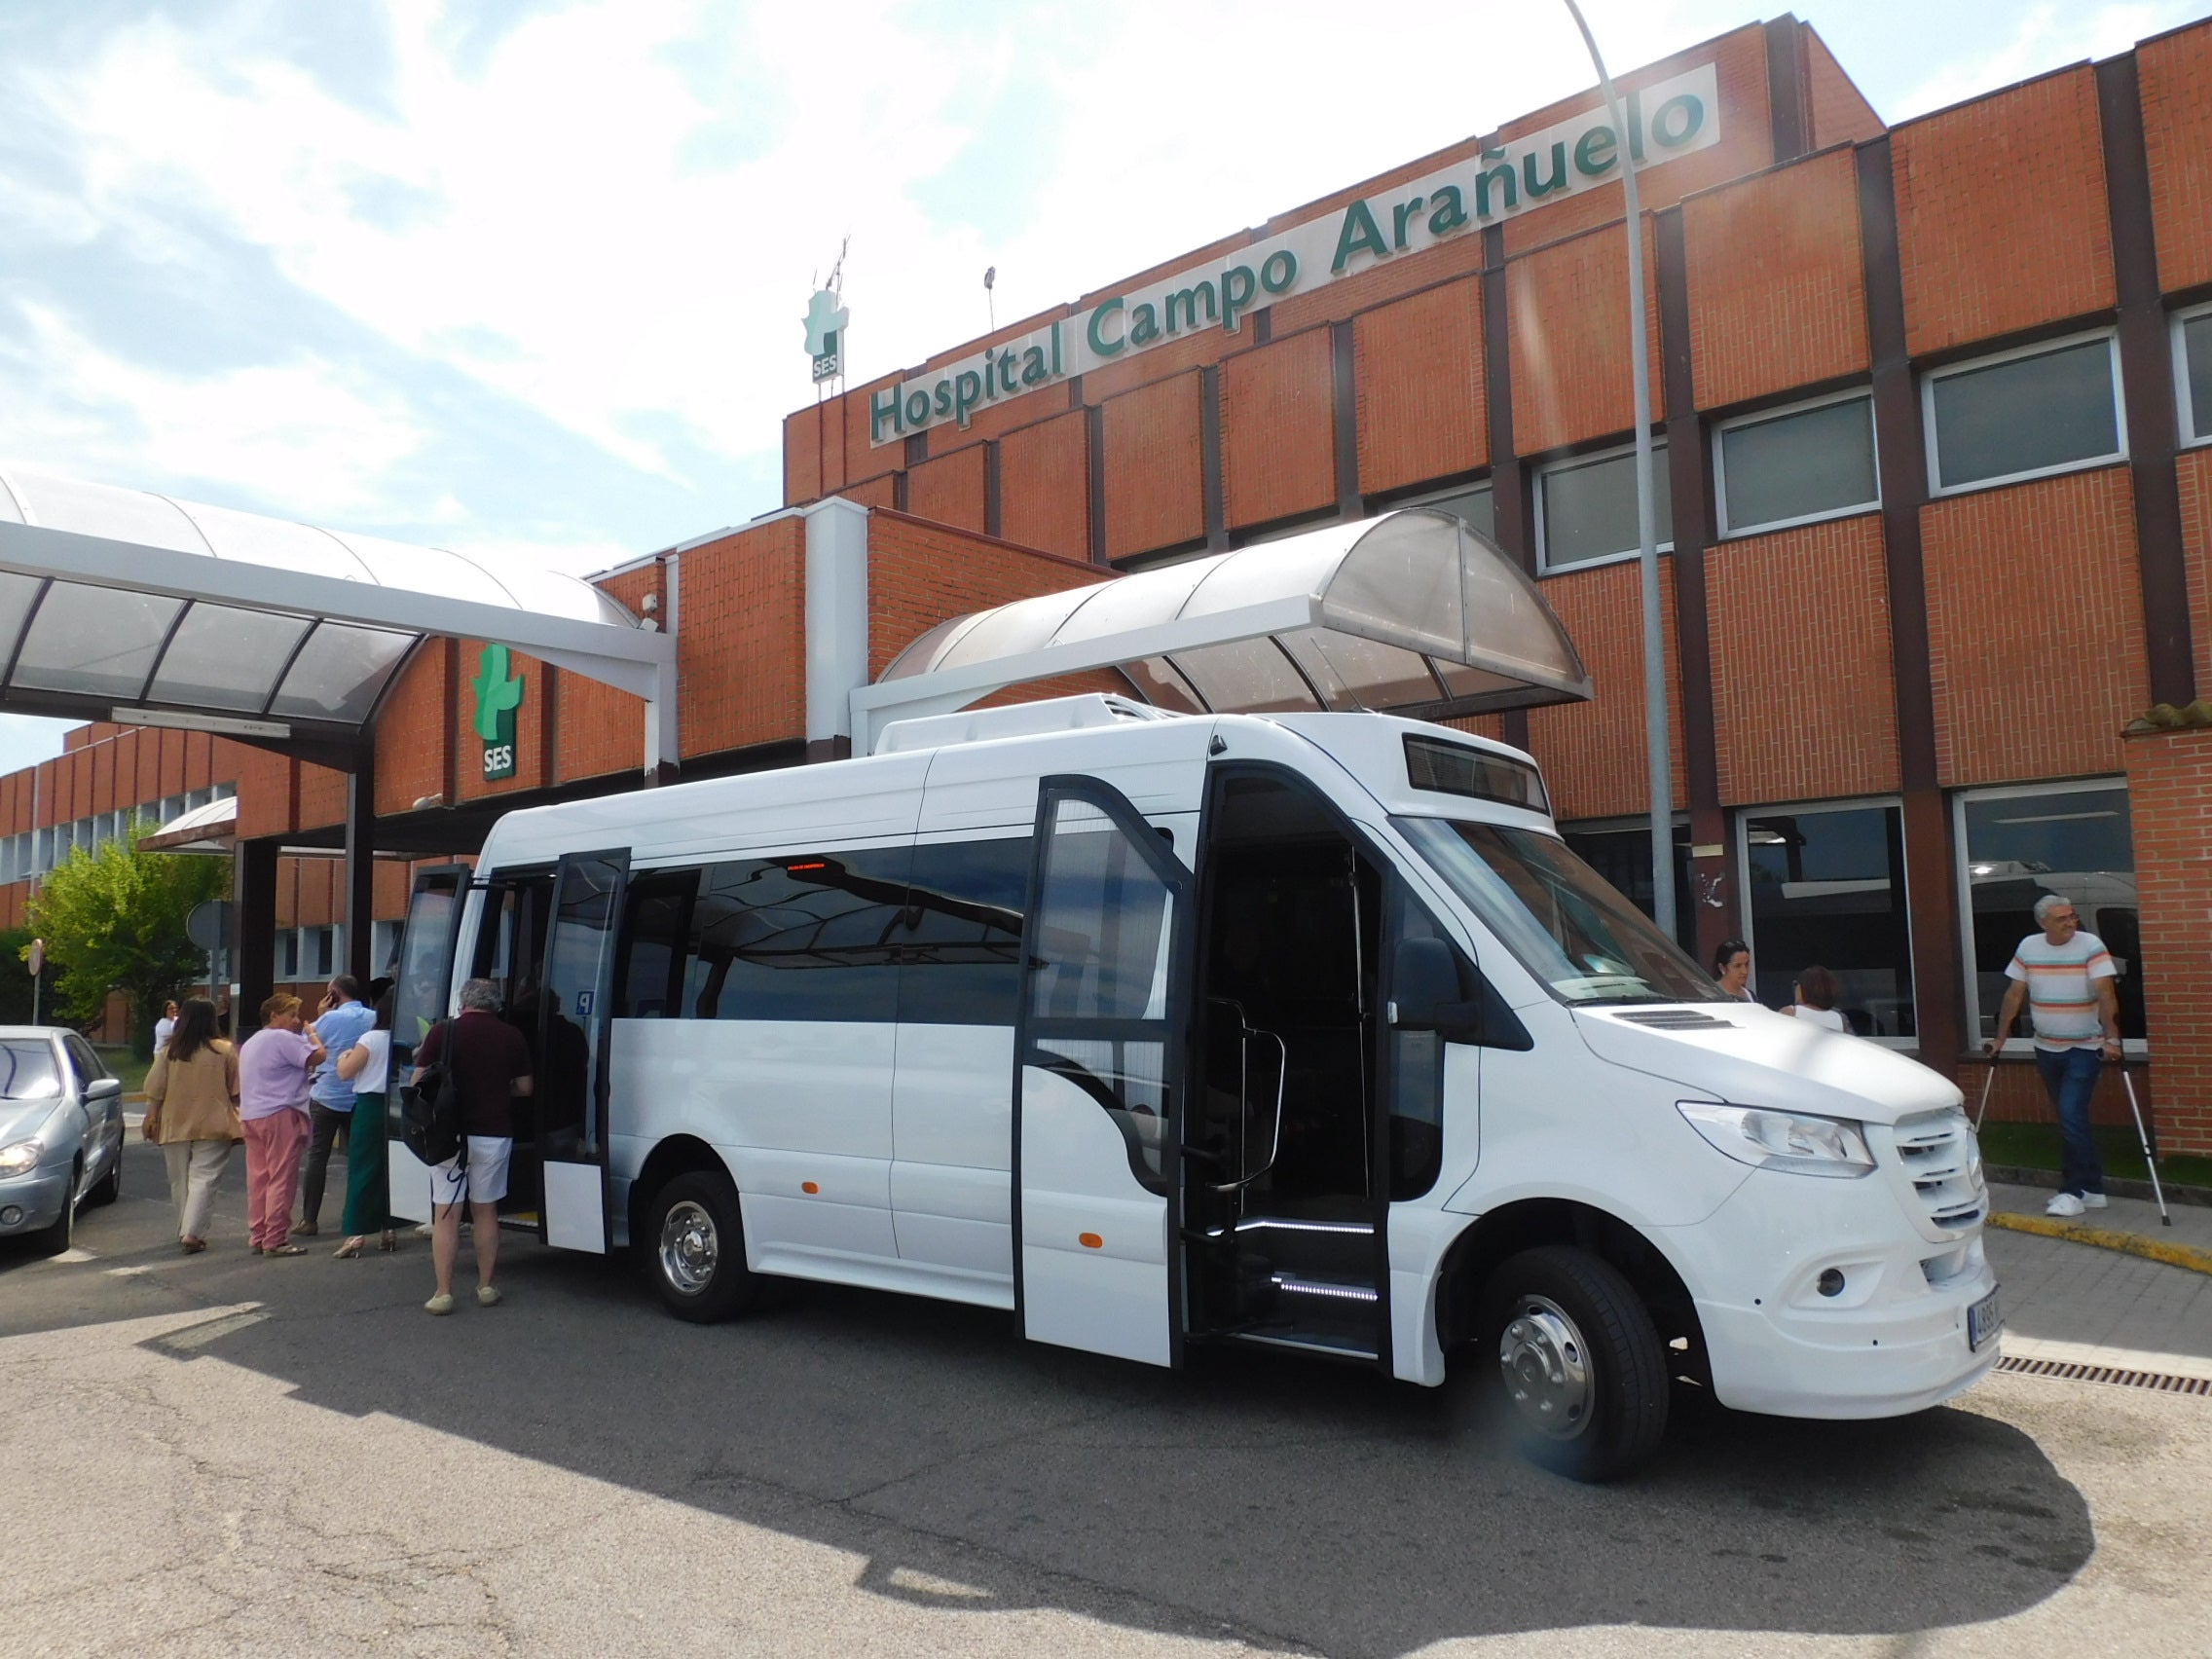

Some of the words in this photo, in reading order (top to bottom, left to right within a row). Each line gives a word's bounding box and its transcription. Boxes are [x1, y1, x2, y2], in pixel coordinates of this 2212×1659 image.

[870, 320, 1062, 440] Hospital
[1087, 250, 1298, 356] Campo
[1331, 90, 1705, 274] Arañuelo
[813, 354, 837, 378] SES
[484, 745, 512, 772] SES
